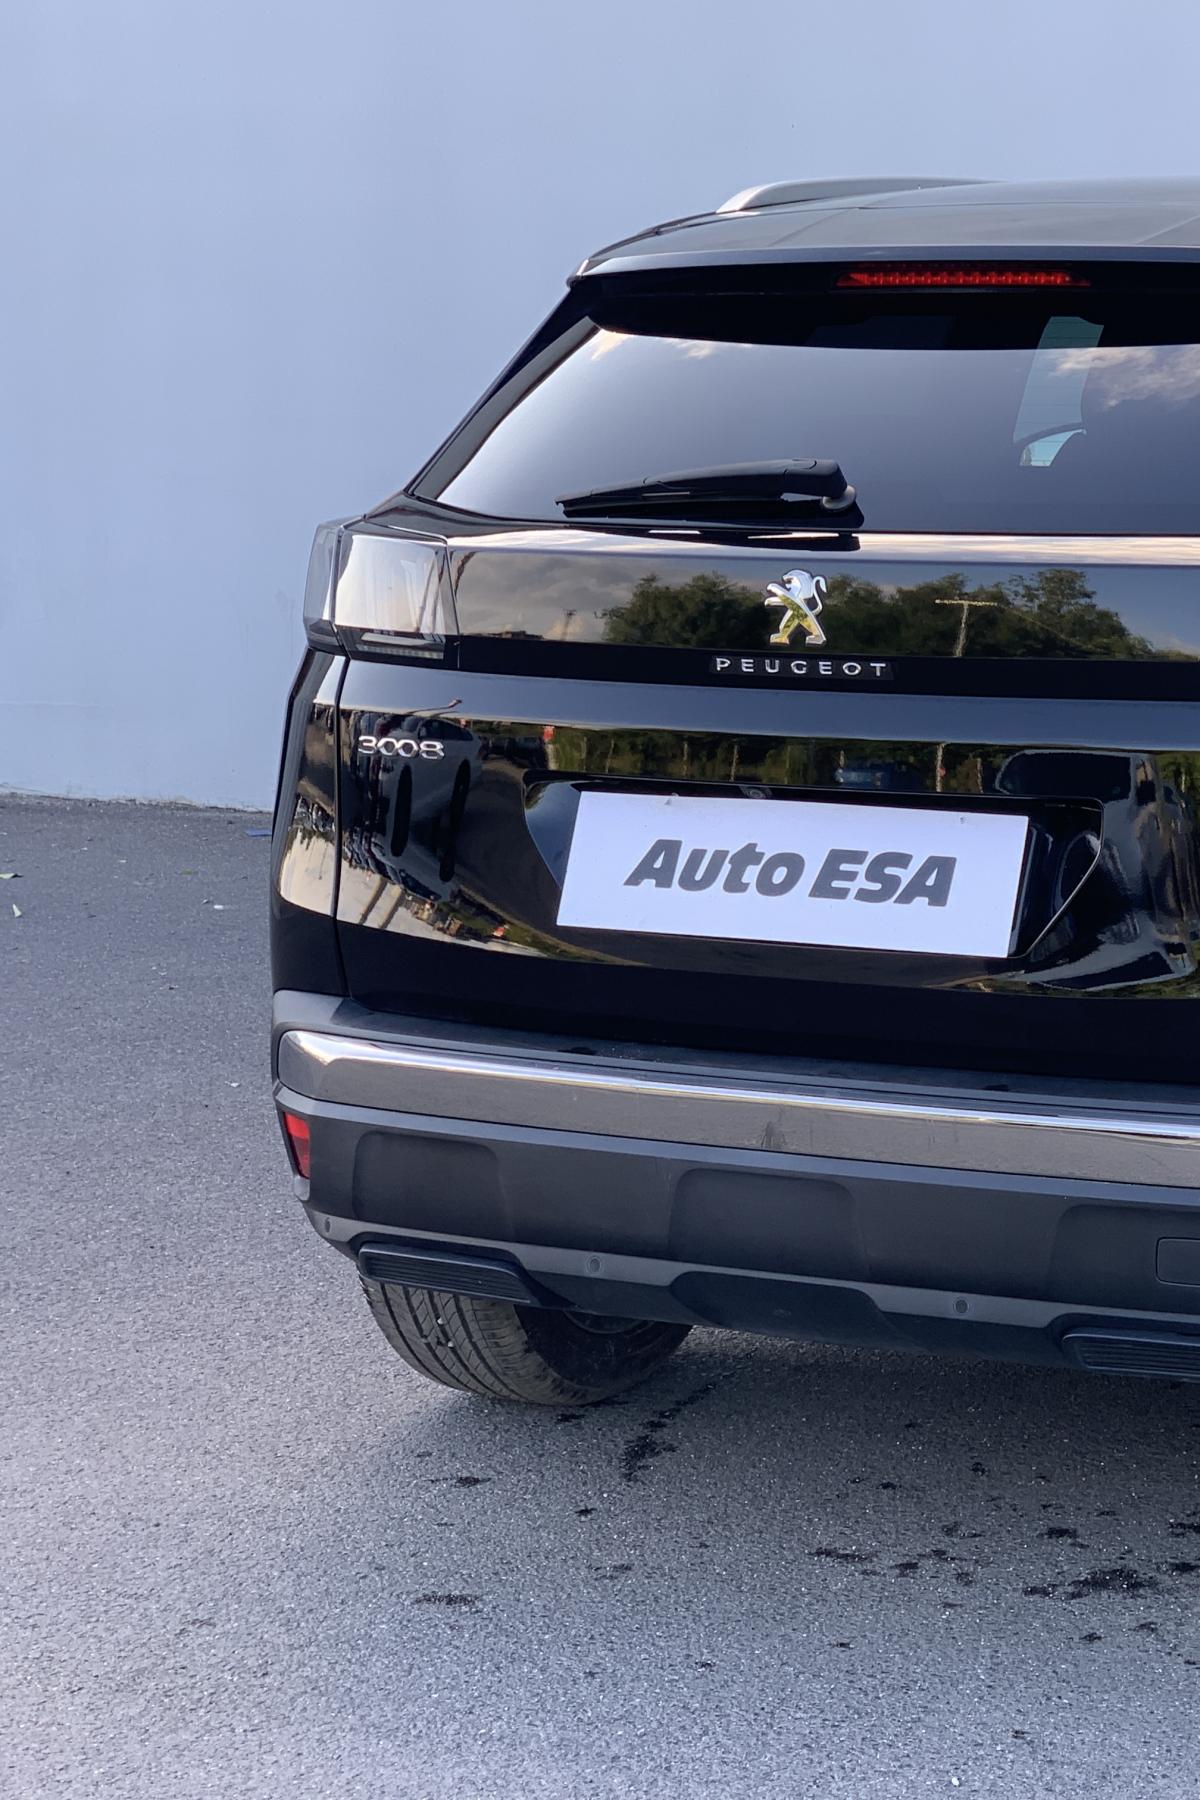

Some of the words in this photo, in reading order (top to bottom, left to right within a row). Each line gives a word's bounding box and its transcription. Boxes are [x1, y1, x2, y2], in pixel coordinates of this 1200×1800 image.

[715, 657, 887, 677] PEUGEOT
[358, 735, 445, 760] 3008
[623, 838, 805, 897] Auto
[808, 848, 957, 907] ESA
